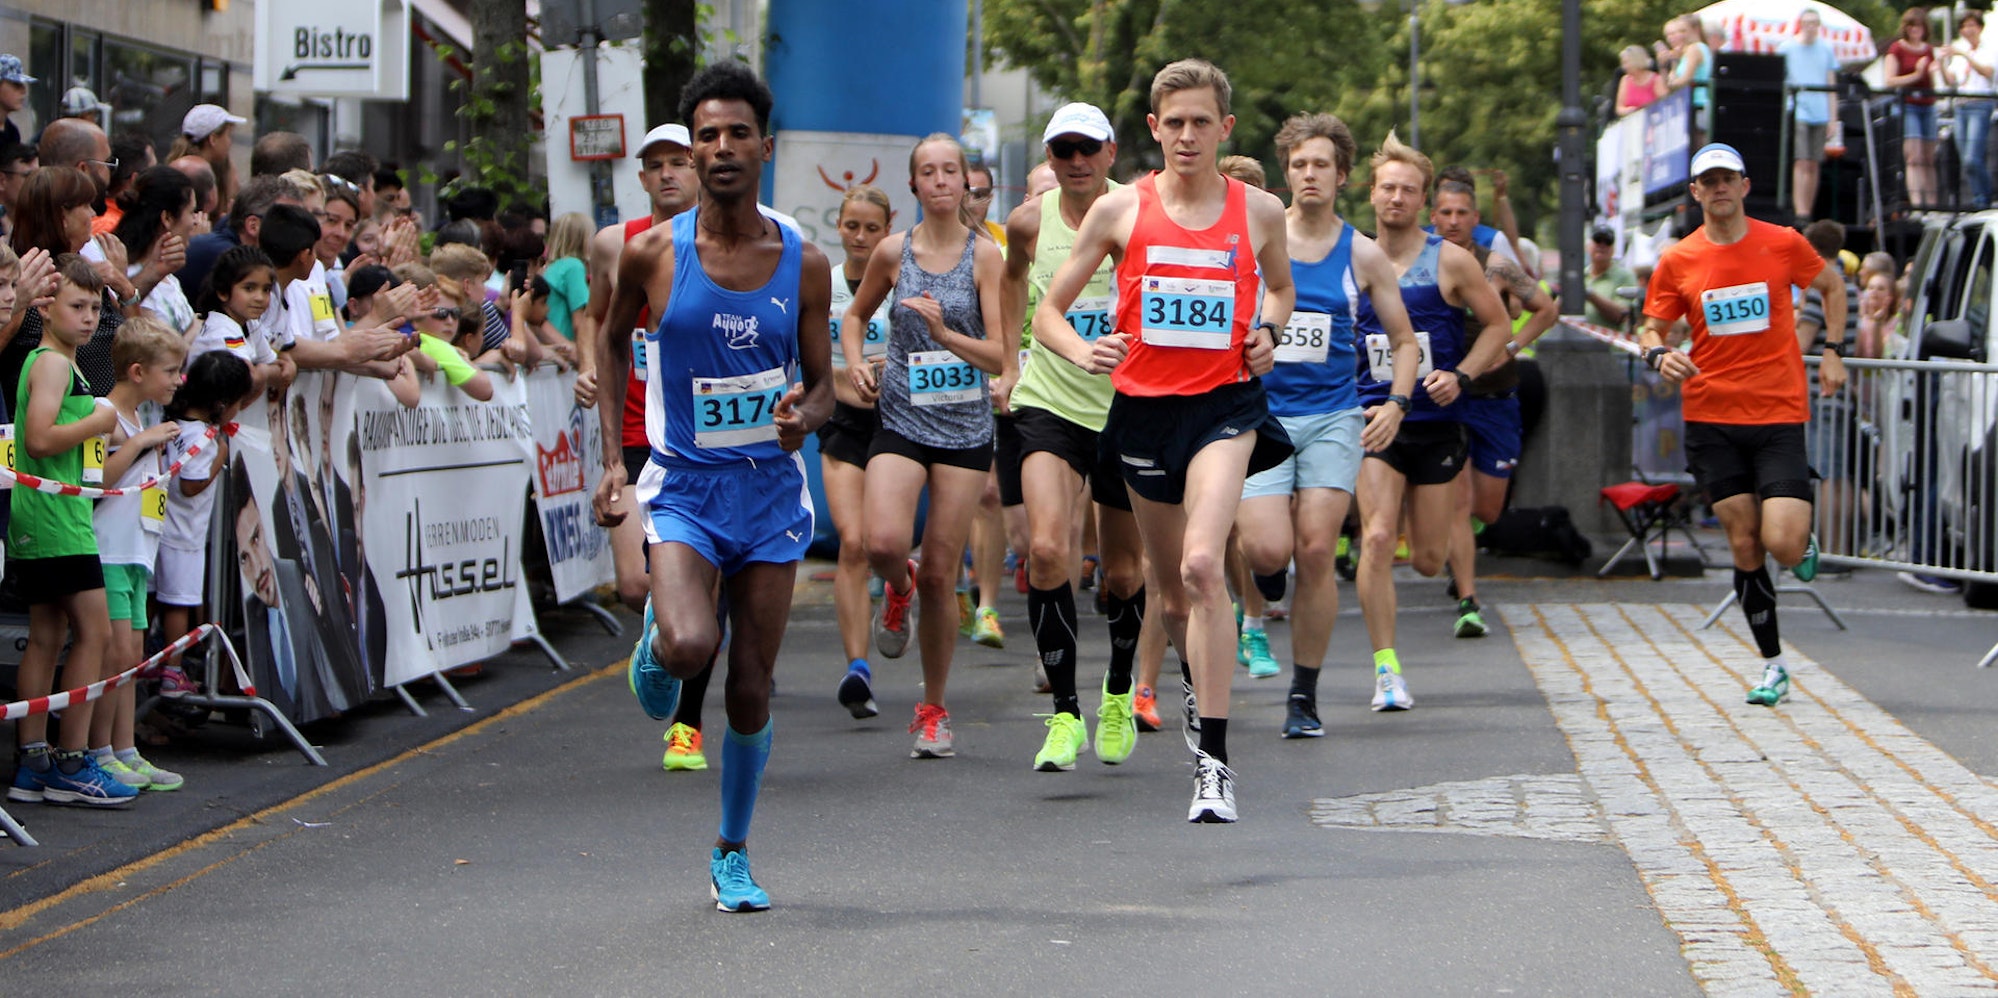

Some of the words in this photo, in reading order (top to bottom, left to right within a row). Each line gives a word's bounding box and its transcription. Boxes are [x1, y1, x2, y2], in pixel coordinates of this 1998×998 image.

[294, 26, 371, 58] Bistro
[1148, 297, 1227, 327] 3184
[1709, 297, 1765, 322] 3150
[829, 321, 879, 341] 38
[1065, 312, 1112, 336] 178
[1281, 326, 1324, 348] 558
[1373, 348, 1425, 367] 759
[915, 365, 975, 390] 3033
[703, 390, 783, 428] 3174
[931, 393, 964, 402] Victoria
